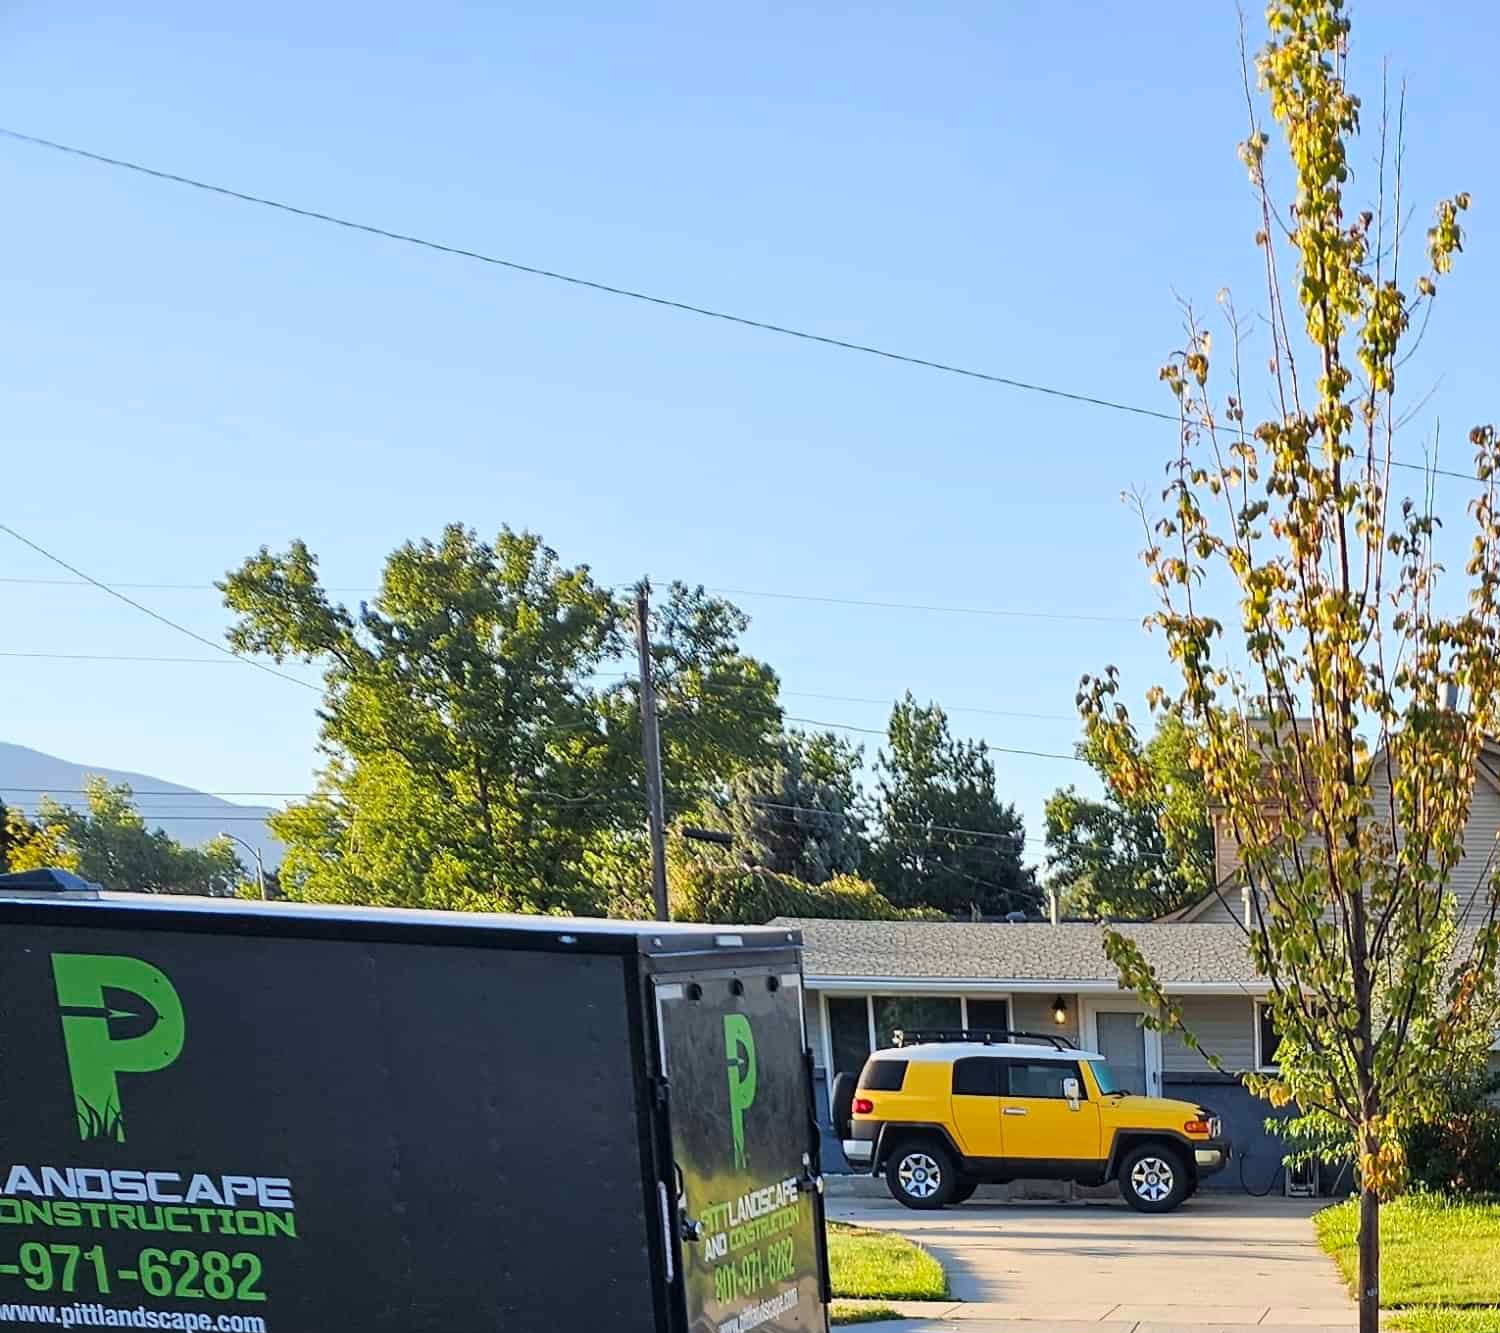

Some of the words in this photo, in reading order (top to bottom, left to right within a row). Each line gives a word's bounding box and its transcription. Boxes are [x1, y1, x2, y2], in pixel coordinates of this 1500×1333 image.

[51, 952, 186, 1143] P
[0, 1165, 295, 1209] ANDSCAPE
[705, 1231, 727, 1263] AND
[729, 1203, 800, 1251] CONSTRUCTION
[715, 1236, 795, 1308] 801-971-6282
